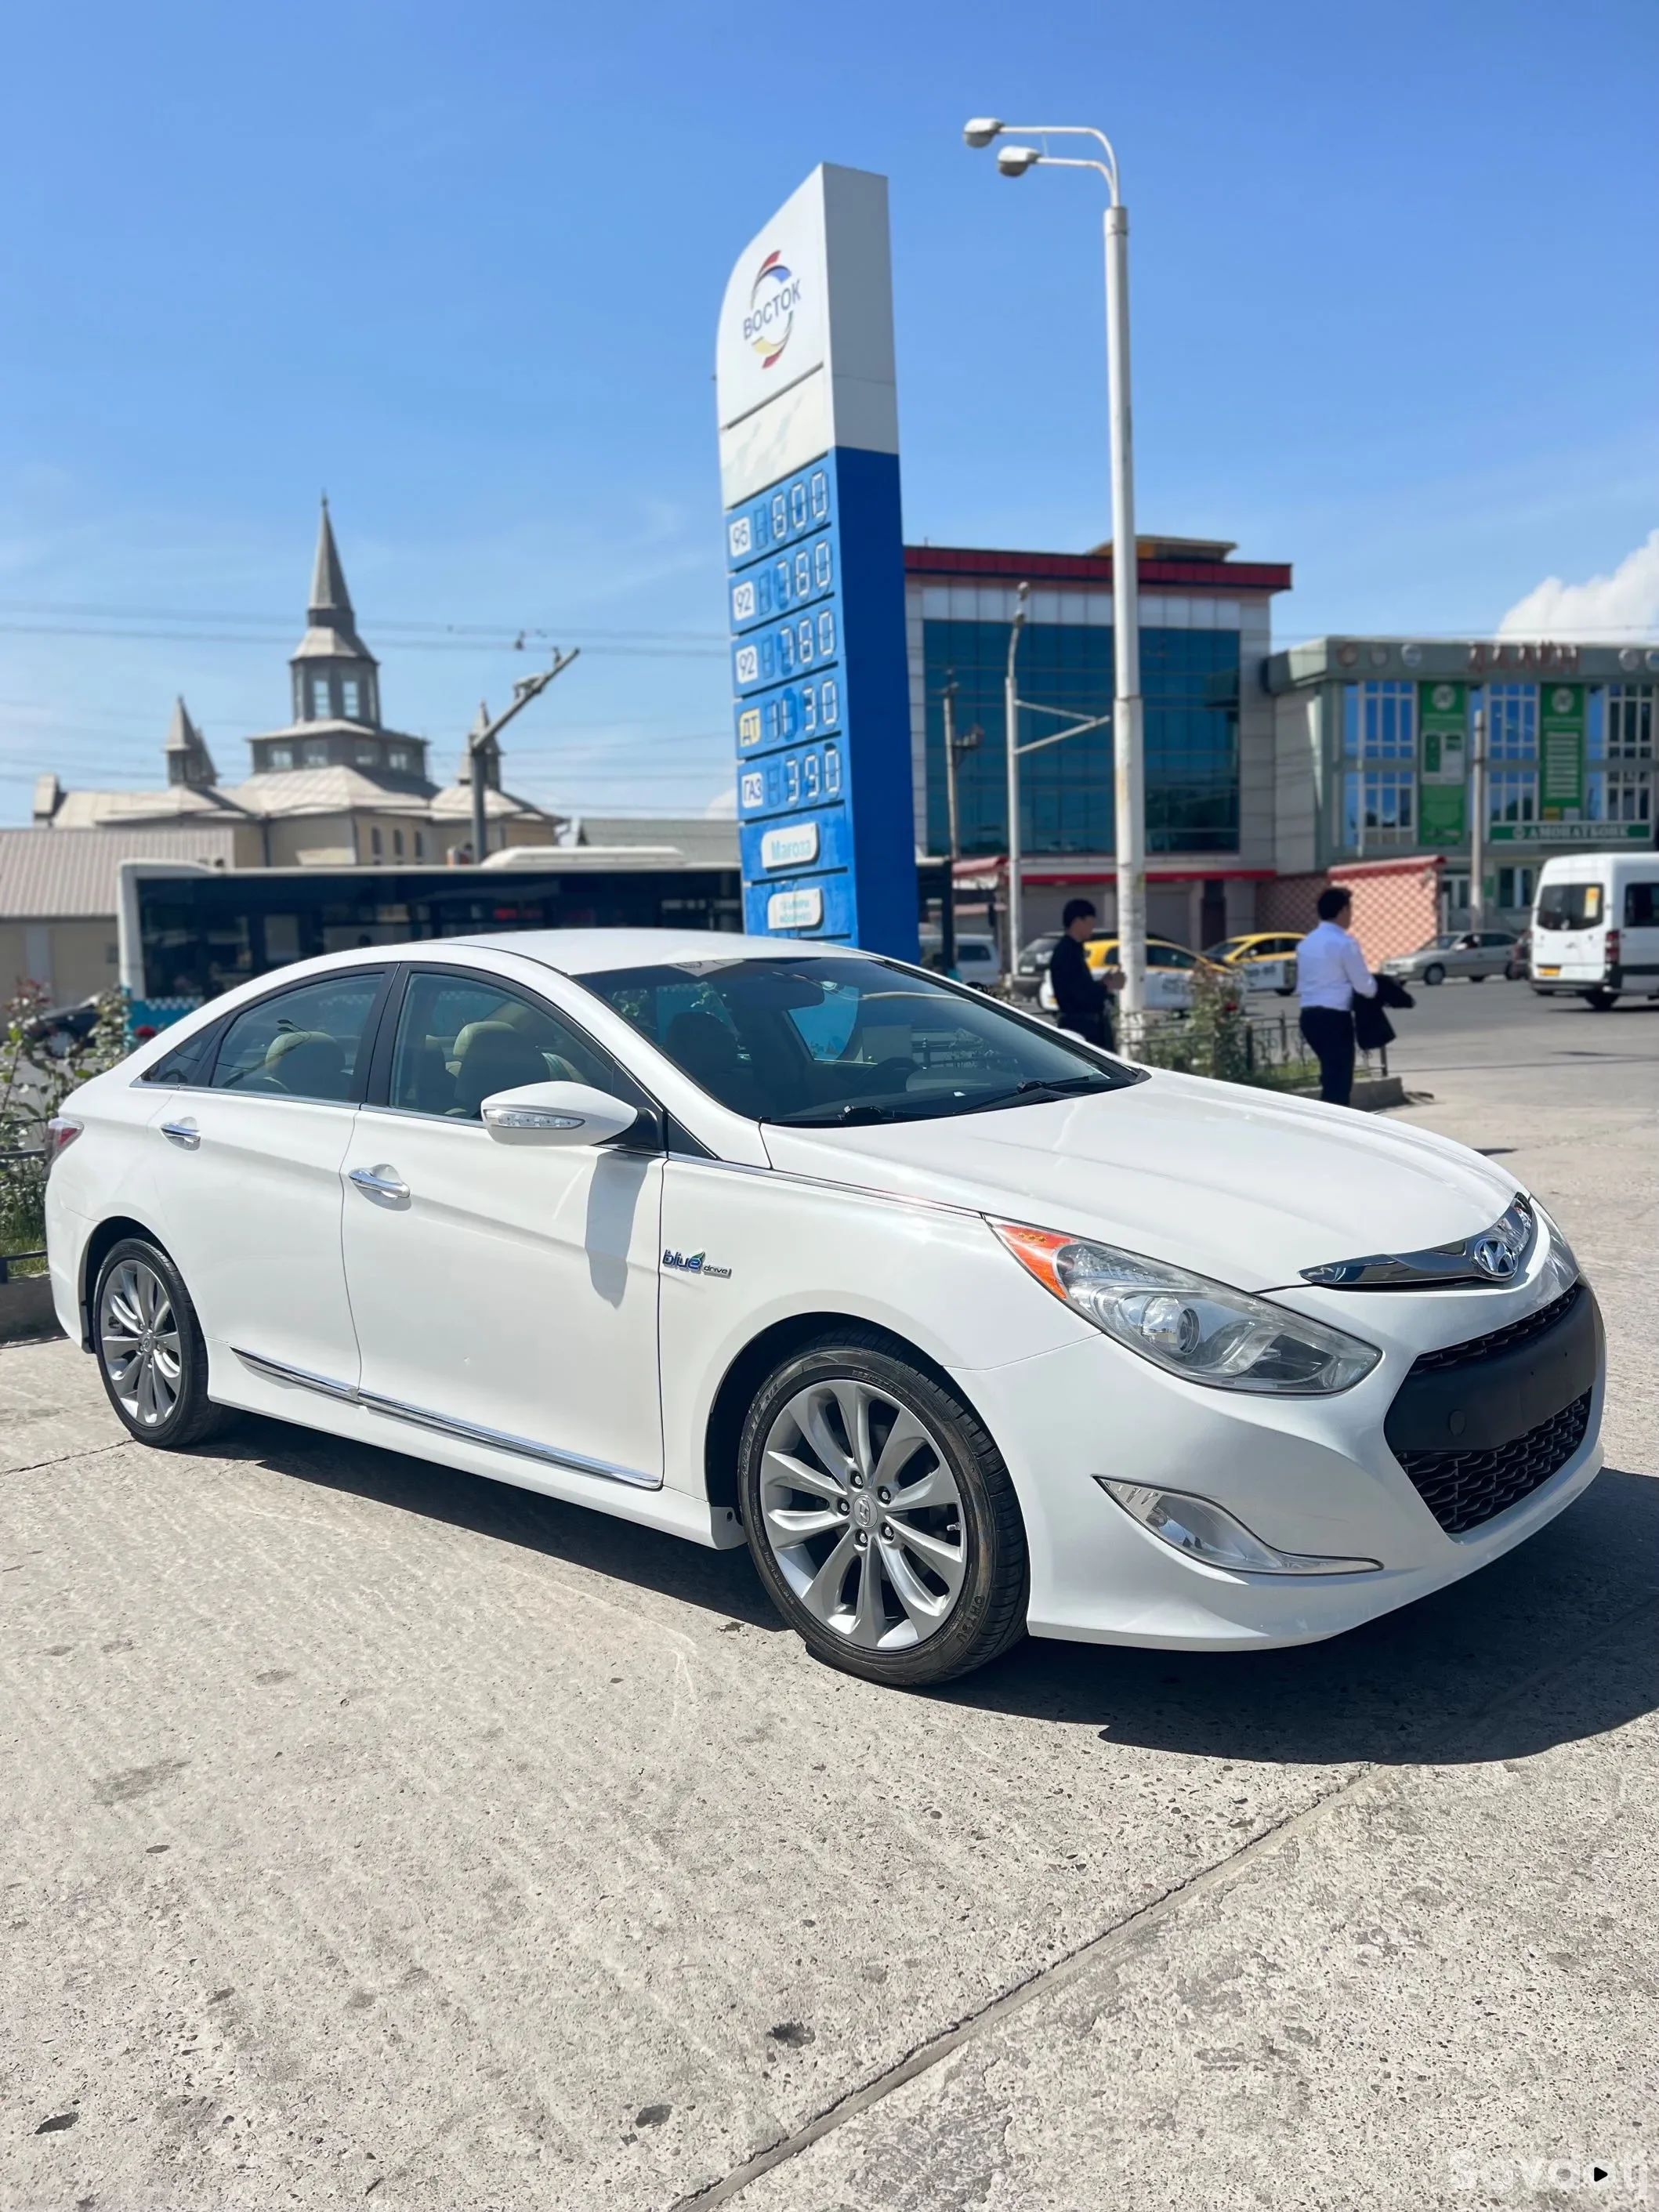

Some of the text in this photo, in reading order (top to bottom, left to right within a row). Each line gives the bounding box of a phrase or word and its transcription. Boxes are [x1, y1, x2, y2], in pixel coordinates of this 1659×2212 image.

[743, 278, 802, 340] ВОСТОК
[733, 523, 748, 552] 95
[735, 588, 751, 614] 92
[738, 652, 755, 677] 92
[742, 715, 759, 743] ДТ
[744, 750, 840, 802] ГАЗ 390
[662, 1249, 728, 1274] blue drive
